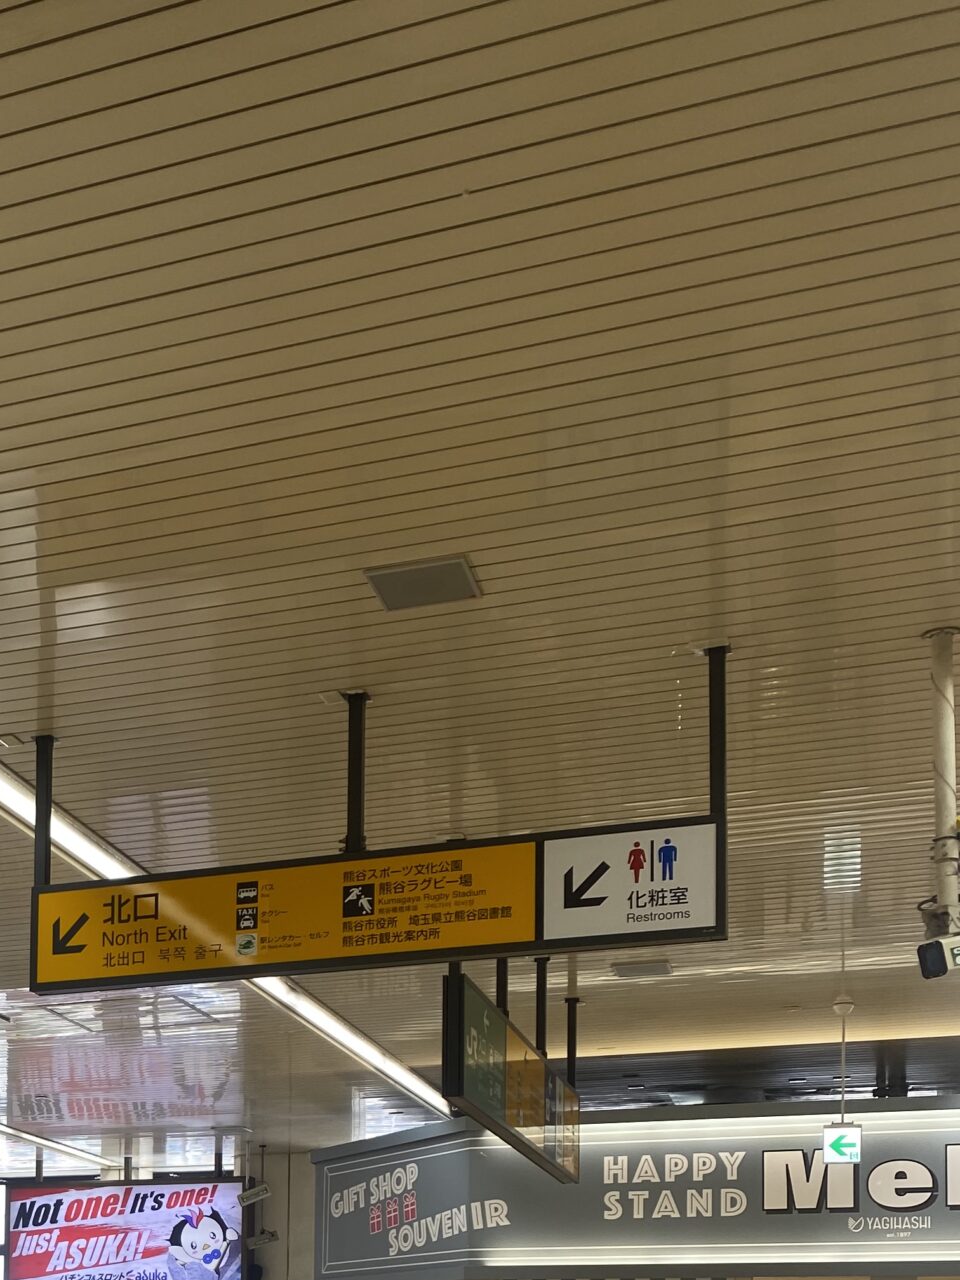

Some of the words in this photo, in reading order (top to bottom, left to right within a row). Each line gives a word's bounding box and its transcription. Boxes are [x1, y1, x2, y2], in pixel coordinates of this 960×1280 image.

[343, 859, 463, 883] 熊谷スポーツ文化公園
[379, 873, 473, 896] 熊谷ラグビー場
[102, 893, 160, 925] 北口
[378, 895, 421, 906] Kumagaya
[424, 892, 450, 902] Rugby
[452, 888, 486, 899] Stadium
[627, 887, 689, 910] 化粧室
[342, 917, 398, 933] 熊谷市役所
[409, 906, 513, 926] 埼玉県立熊谷図書館
[627, 909, 691, 923] Restrooms
[102, 929, 149, 947] North
[156, 925, 188, 943] Exit
[342, 928, 441, 948] 熊谷市観光案内所
[102, 951, 145, 968] 北出口
[158, 946, 186, 962] 북쪽
[194, 943, 224, 959] 출구
[603, 1151, 746, 1184] HAPPY
[762, 1144, 960, 1214] Me
[330, 1181, 367, 1218] GIFT
[369, 1163, 419, 1204] SHOP
[12, 1198, 64, 1229] Not
[64, 1187, 133, 1223] one!
[130, 1191, 165, 1214] It's
[166, 1184, 219, 1209] one!
[603, 1188, 747, 1220] STAND
[389, 1199, 511, 1256] SOUVENIR
[867, 1216, 931, 1230] YAGIHASHI
[45, 1230, 152, 1272] ASUKA!
